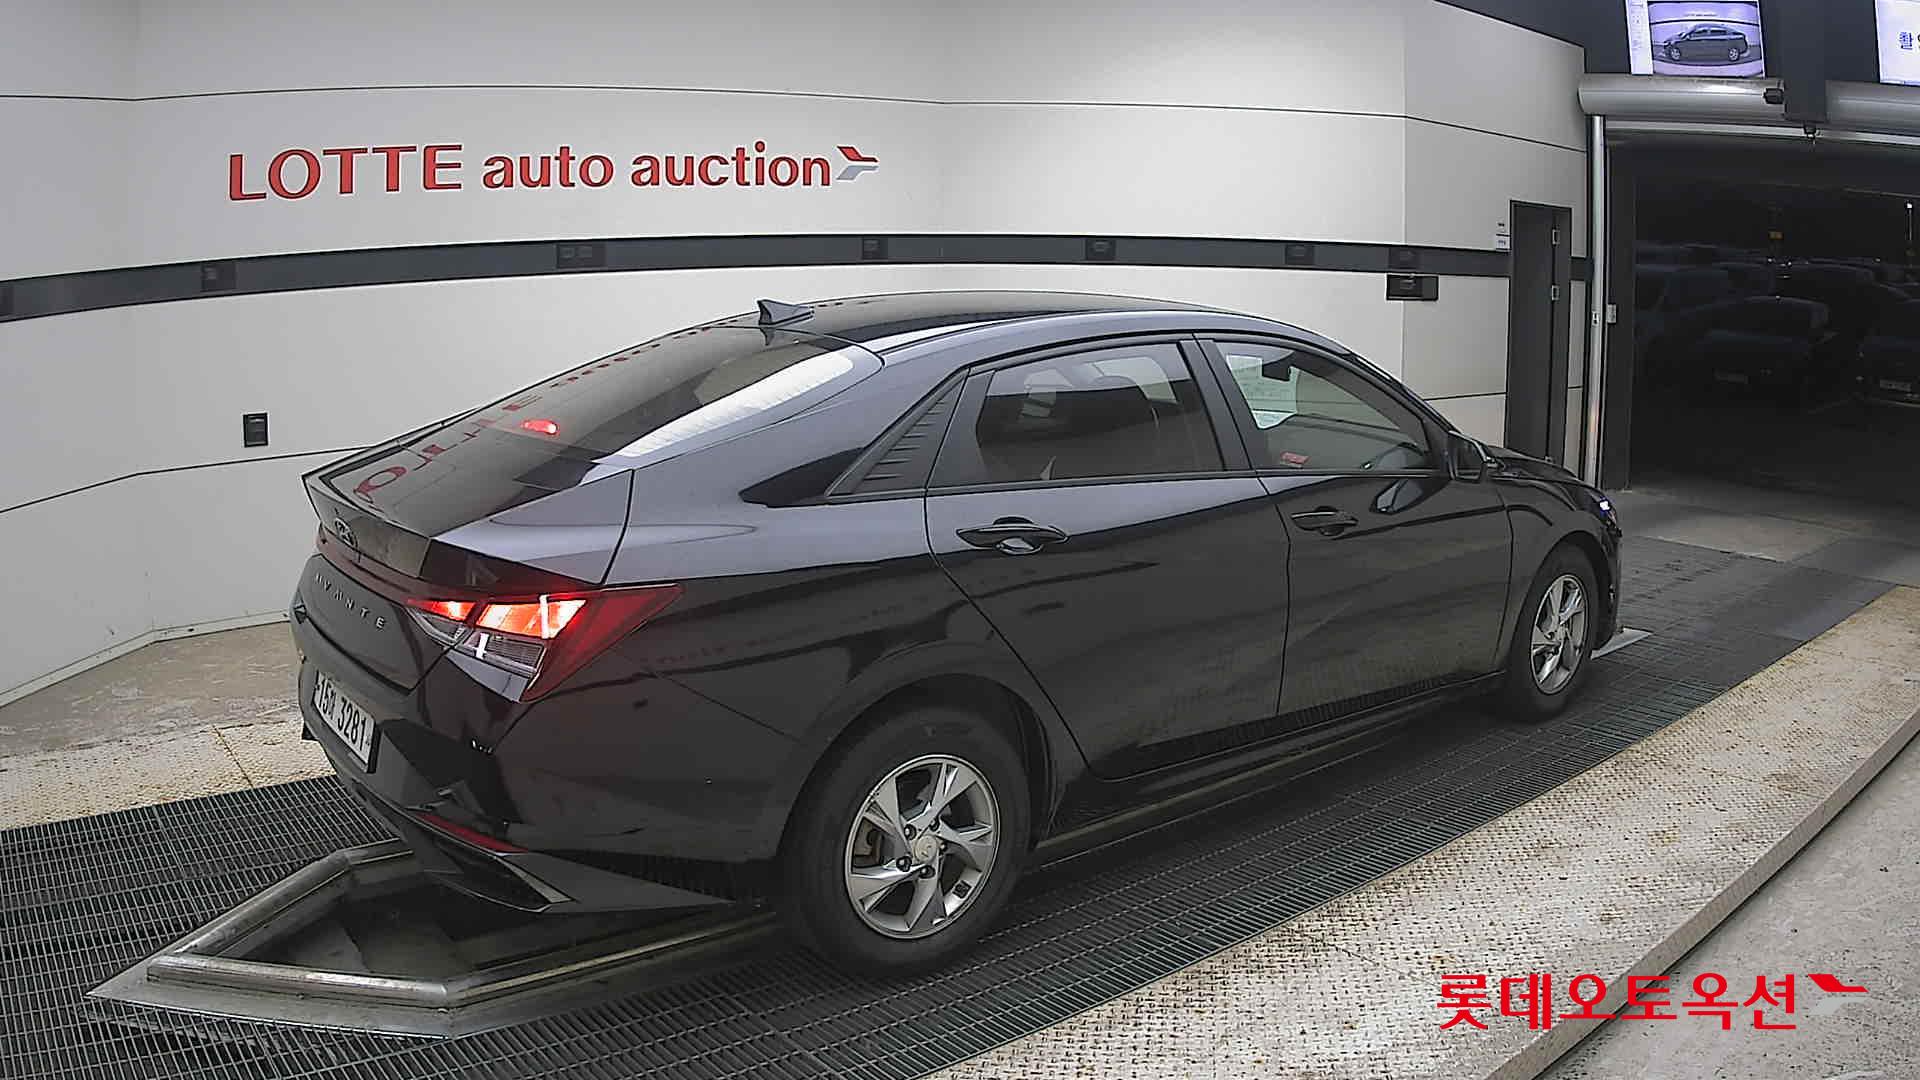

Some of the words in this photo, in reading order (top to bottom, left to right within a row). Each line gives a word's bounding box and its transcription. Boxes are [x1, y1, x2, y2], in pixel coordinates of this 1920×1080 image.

[229, 144, 463, 201] LOTTE
[482, 146, 614, 189] auto
[630, 140, 831, 188] auction
[338, 696, 366, 751] 3281
